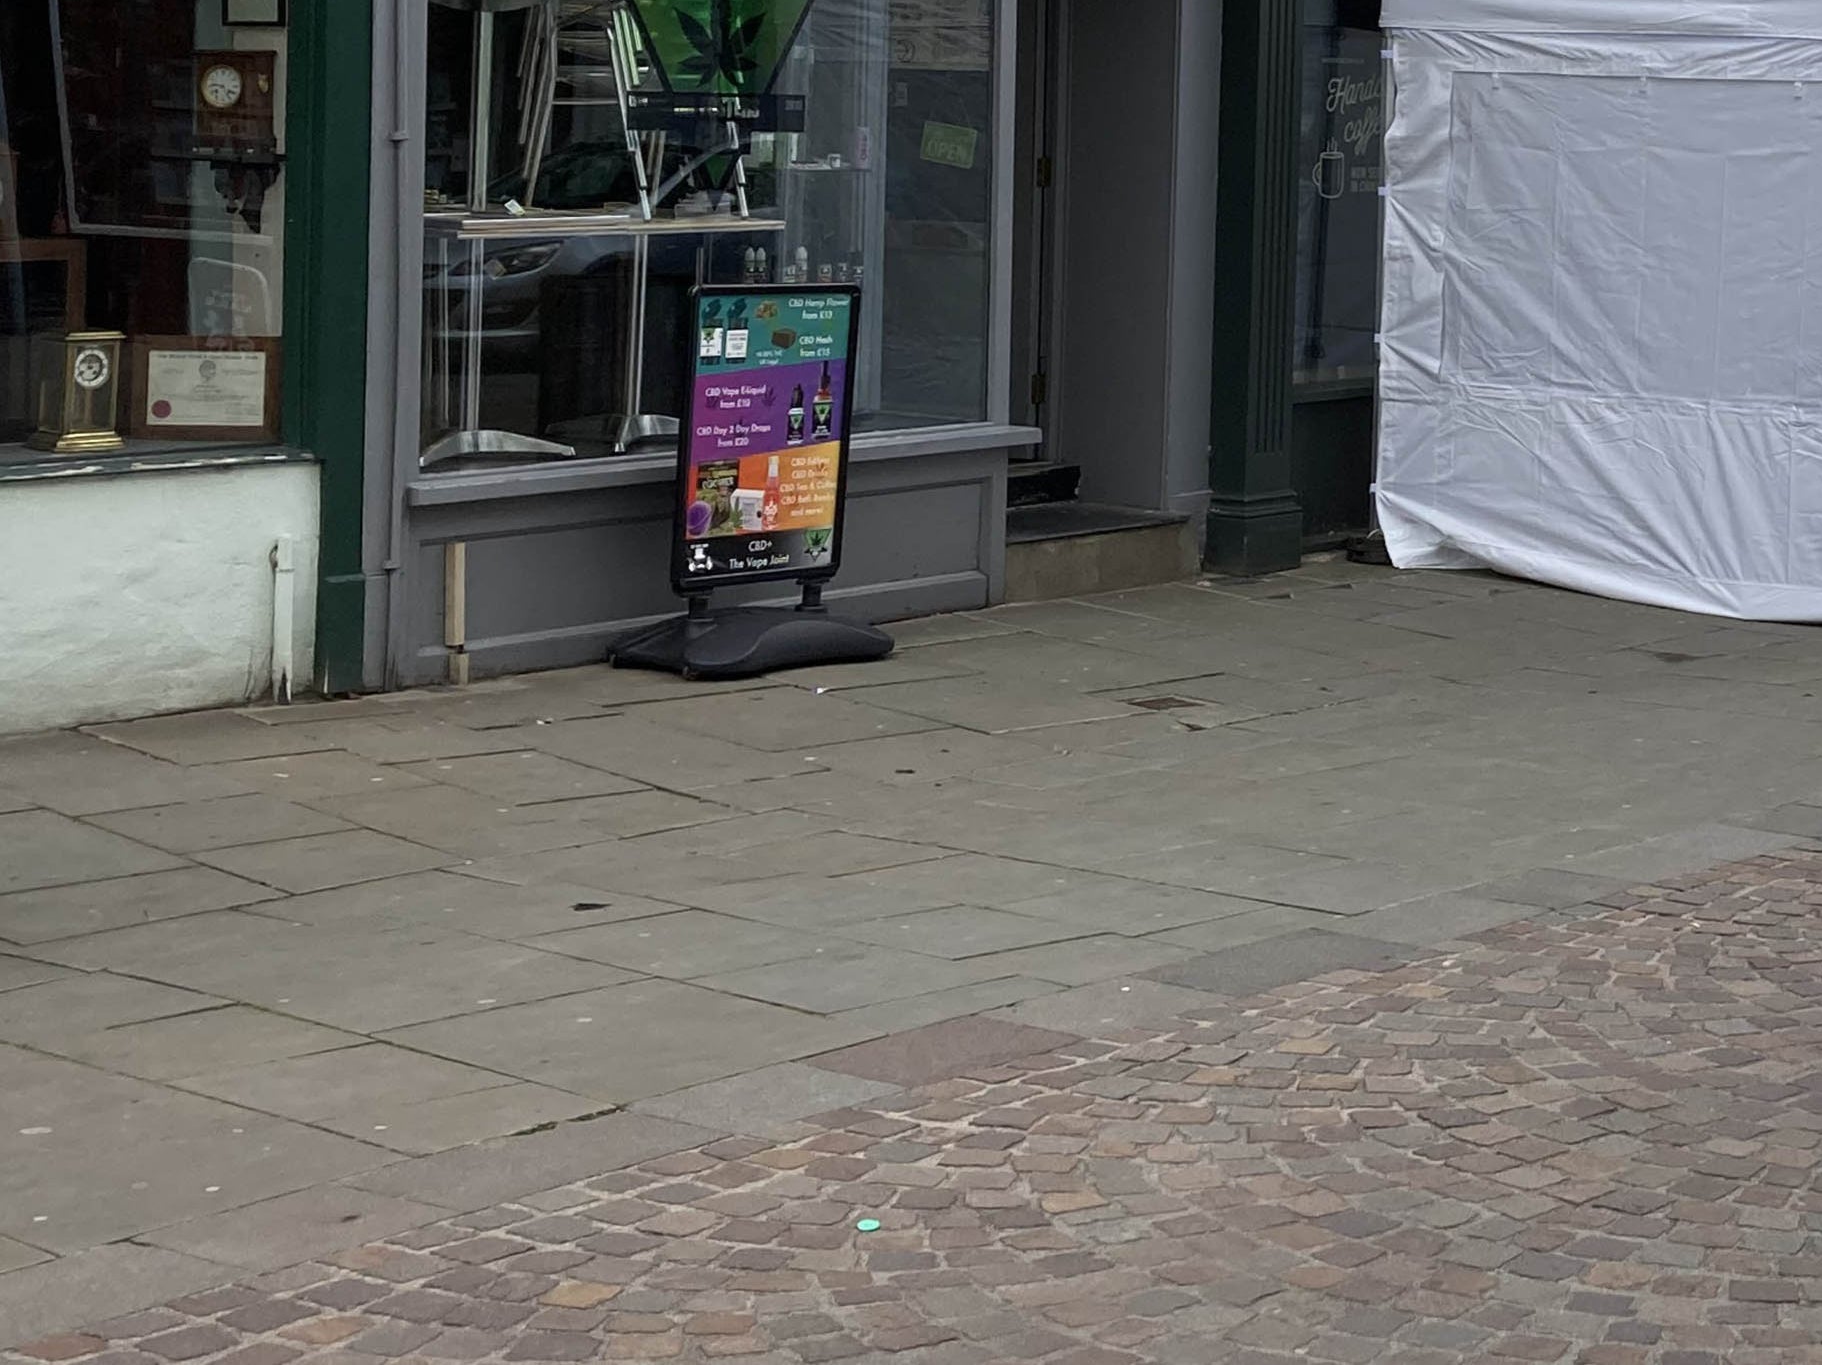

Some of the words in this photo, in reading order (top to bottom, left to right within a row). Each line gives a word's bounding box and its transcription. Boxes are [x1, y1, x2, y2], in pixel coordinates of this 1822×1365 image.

[788, 298, 803, 307] CBD
[805, 297, 825, 309] Hemp
[802, 311, 818, 320] from
[799, 336, 814, 345] CBD
[800, 348, 816, 357] from
[705, 387, 721, 397] CBD
[722, 387, 740, 397] Vape
[696, 426, 711, 436] CBD
[736, 424, 750, 435] Day
[748, 540, 773, 552] CBD+
[729, 558, 744, 569] The
[746, 557, 768, 569] Vape
[769, 554, 790, 566] Joint
